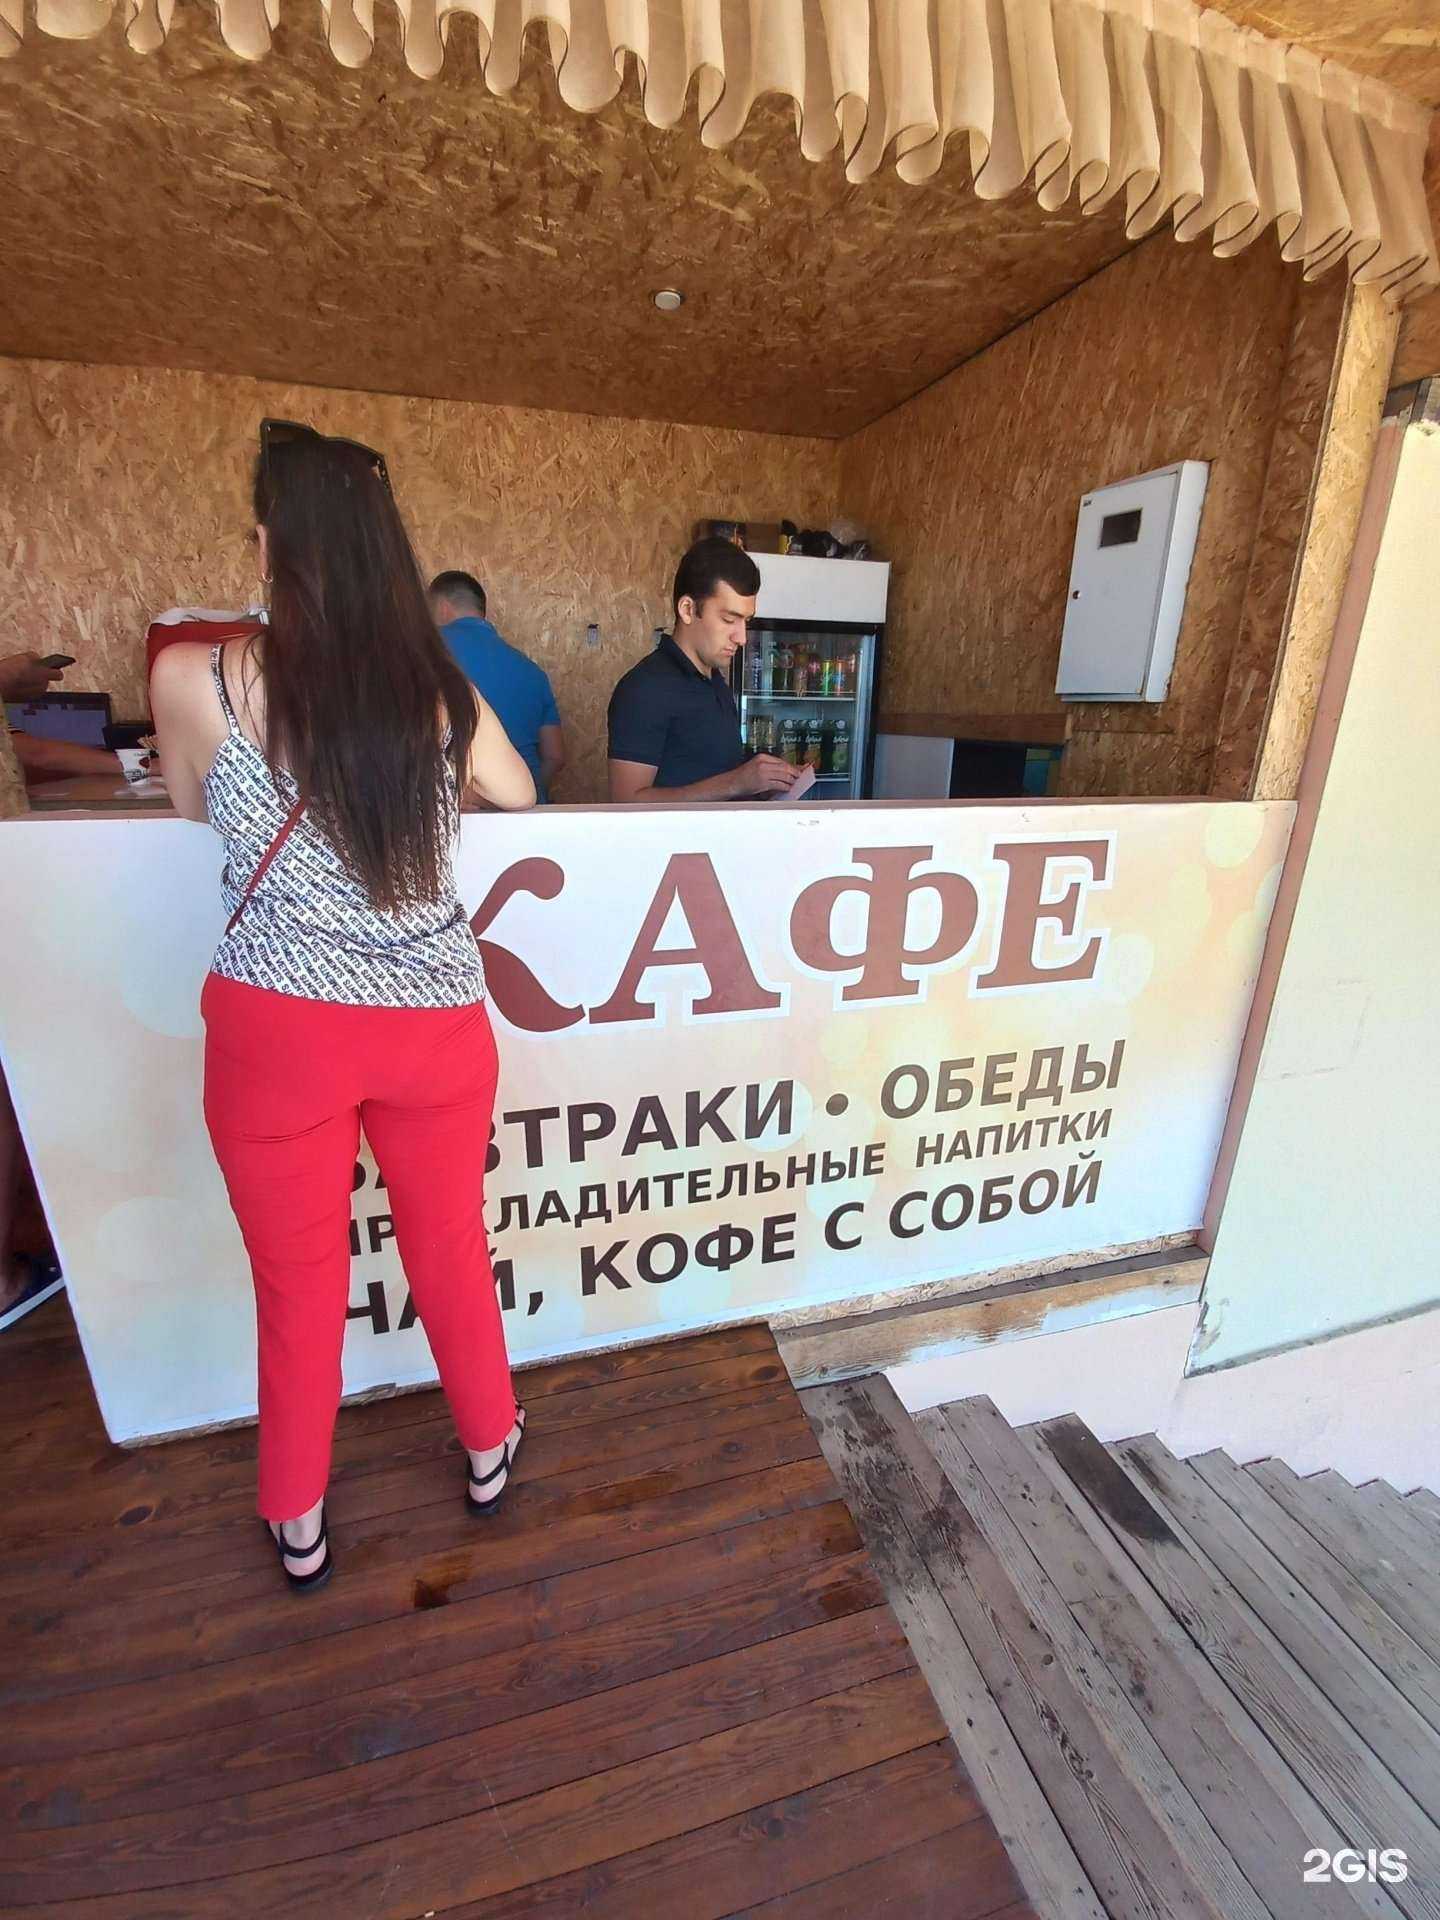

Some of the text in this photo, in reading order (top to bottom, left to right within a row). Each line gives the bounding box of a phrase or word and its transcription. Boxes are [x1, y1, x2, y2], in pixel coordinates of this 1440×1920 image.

[214, 751, 247, 784] TEMENTS
[228, 734, 262, 770] TEMENTS
[222, 768, 259, 814] VETEMENTS
[234, 752, 277, 802] VETEMENTS
[245, 784, 287, 823] ETEMENTS
[284, 845, 320, 877] TEMENTS
[293, 828, 335, 865] ETEMENTS
[273, 857, 306, 890] TEMENTS
[292, 863, 337, 901] VETEMENTS
[306, 851, 351, 888] VETEMENTS
[296, 949, 327, 990] VETEMENTS
[311, 938, 345, 979] VETEMENTS
[351, 1039, 1127, 1193] ТРАКИ ОБЕДЫ
[349, 1108, 1112, 1257] РЛАДИТЕЛЬНЫЕ НАПИТКИ
[580, 1212, 797, 1297] КОФЕ
[824, 1202, 865, 1251] С
[888, 1150, 1103, 1239] СОБОЙ
